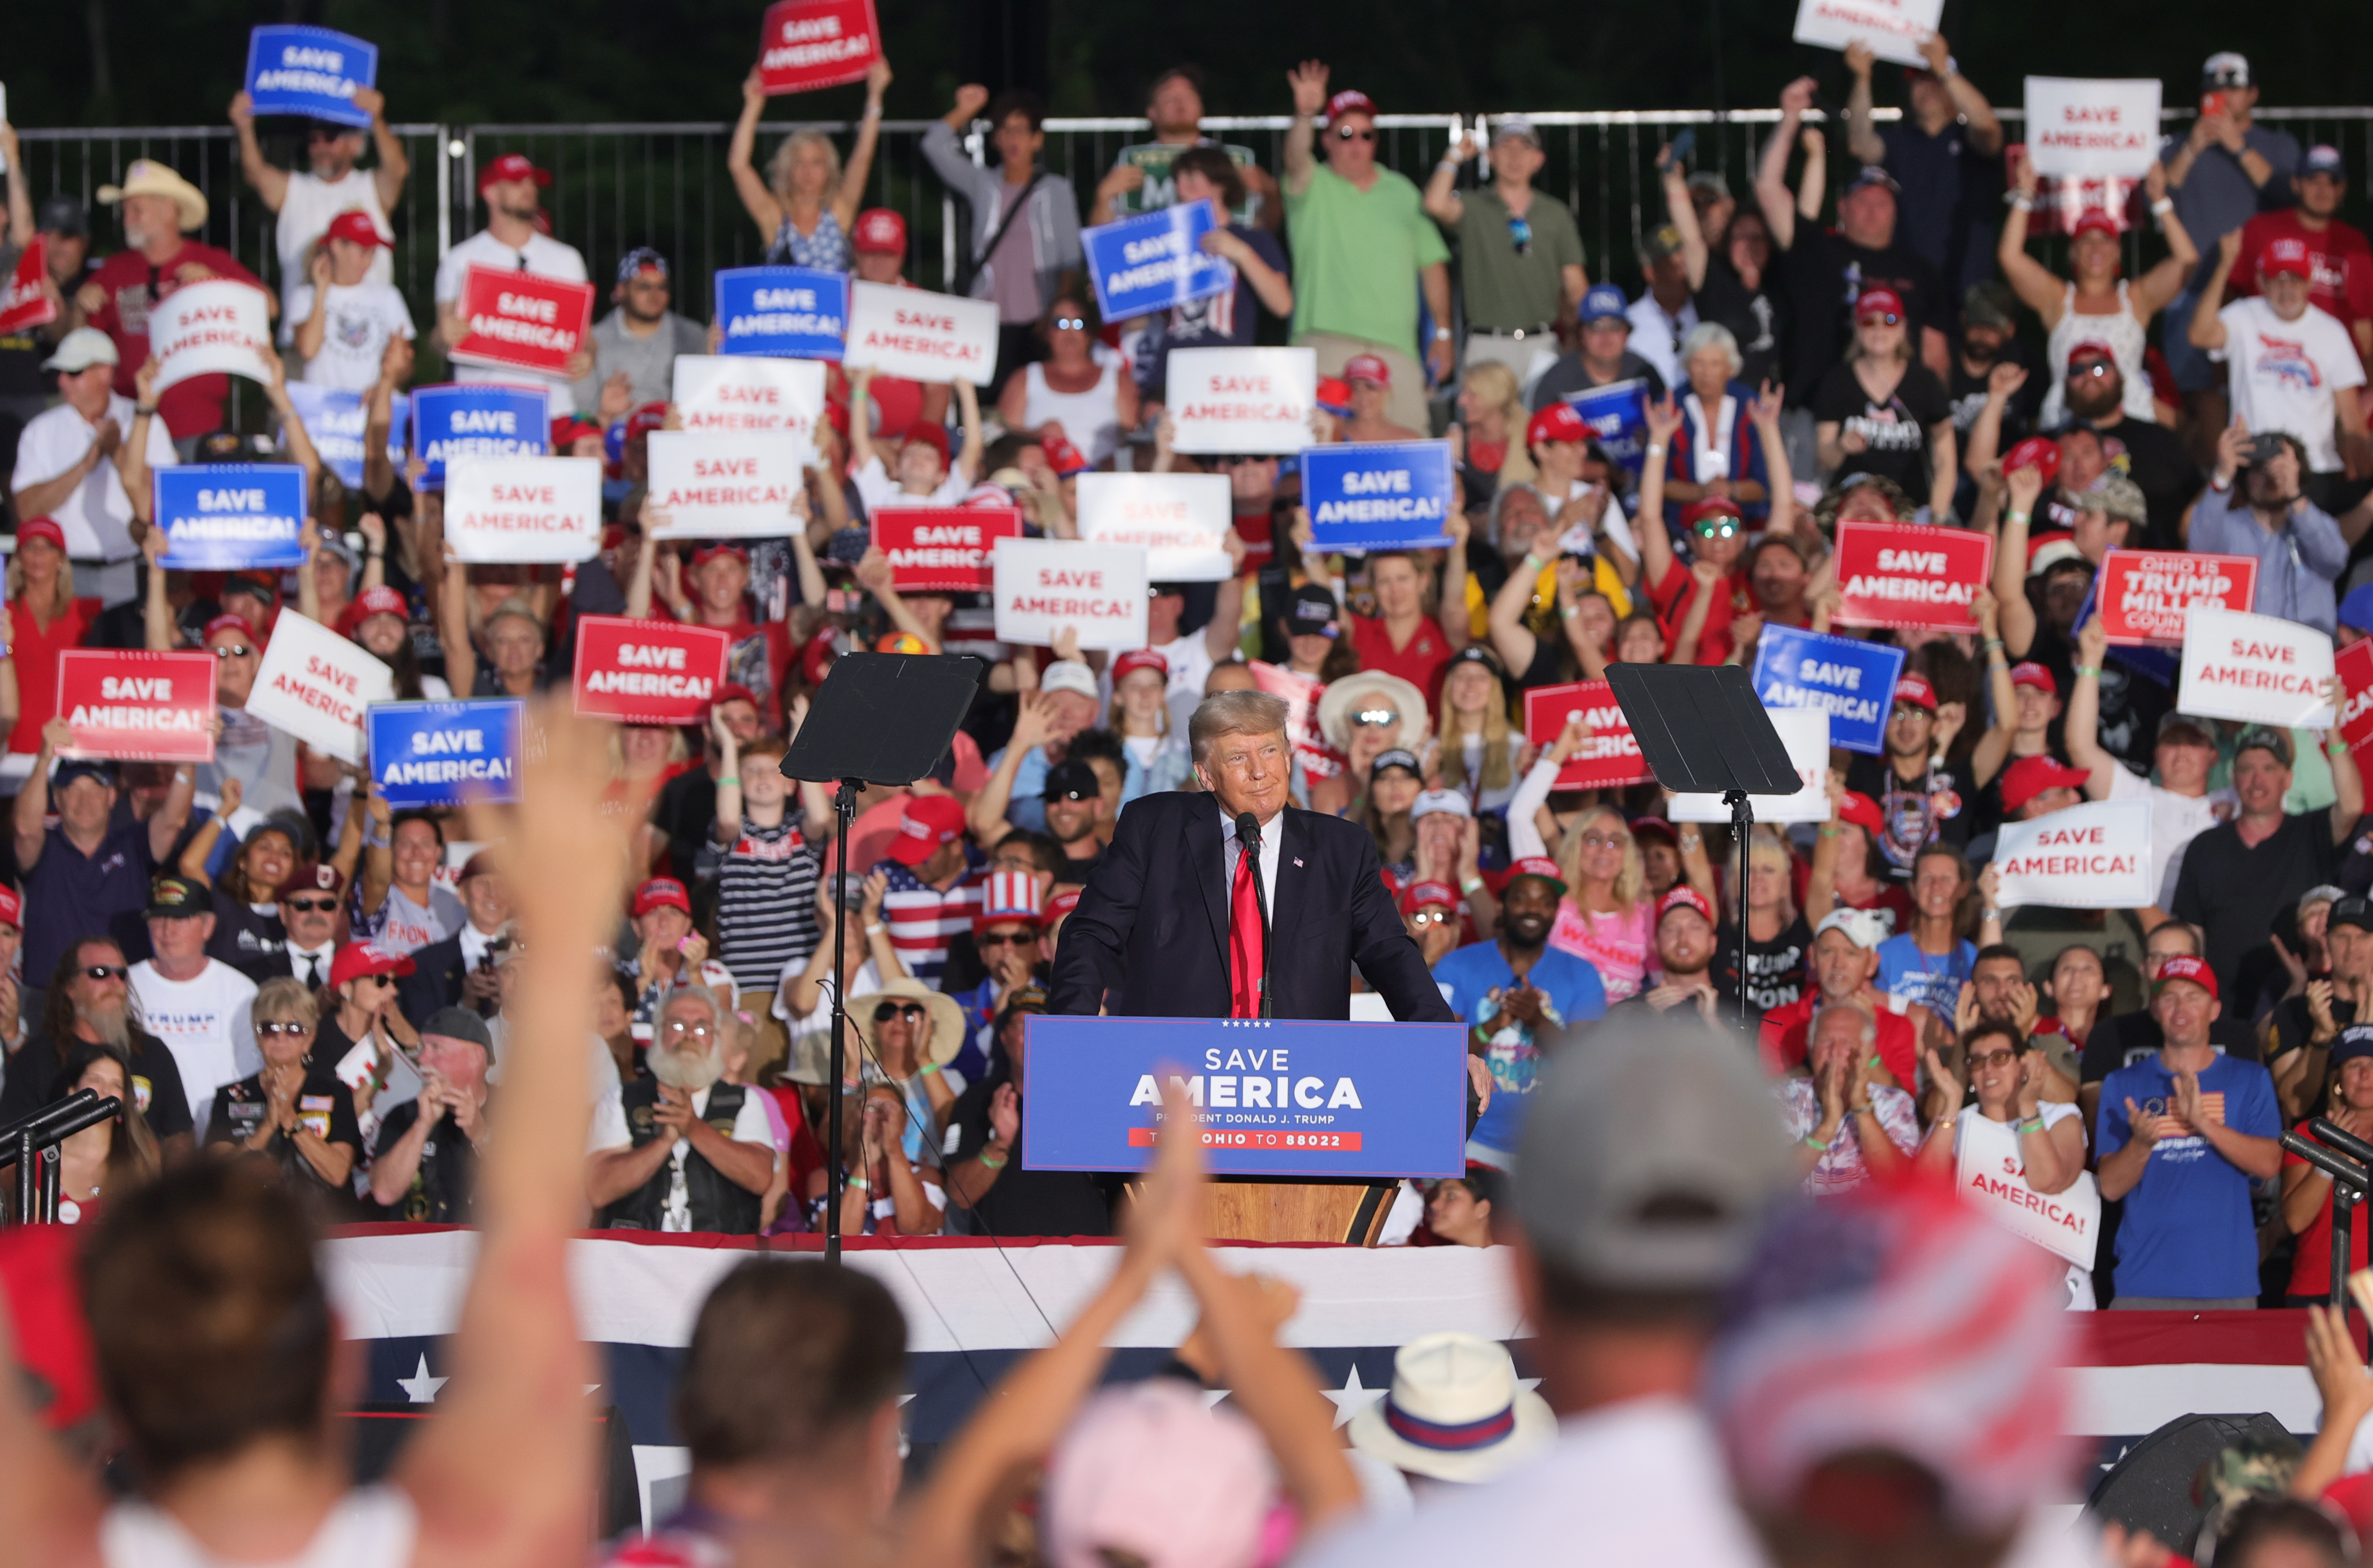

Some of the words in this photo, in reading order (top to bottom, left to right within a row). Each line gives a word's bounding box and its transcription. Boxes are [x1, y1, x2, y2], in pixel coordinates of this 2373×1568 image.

[782, 15, 840, 41] SAVE
[282, 45, 343, 72] SAVE
[763, 33, 869, 69] AMERICA!
[255, 68, 359, 98] AMERICA
[2064, 105, 2121, 123] SAVE
[2041, 131, 2146, 150] AMERICA!
[1123, 232, 1186, 263] SAVE
[498, 292, 560, 322] SAVE
[753, 288, 816, 311] SAVE
[179, 306, 238, 326] SAVE
[728, 314, 841, 338] AMERICA!
[894, 309, 956, 331] SAVE
[467, 313, 578, 352] AMERICA!
[865, 333, 982, 362] AMERICA!
[720, 385, 779, 404] SAVE
[1209, 376, 1271, 393] SAVE
[451, 410, 516, 434] SAVE
[1182, 404, 1300, 422] AMERICA!
[425, 437, 541, 461] AMERICA!
[694, 459, 757, 478] SAVE
[493, 484, 556, 504] SAVE
[1343, 470, 1412, 495] SAVE
[197, 489, 265, 511] SAVE
[666, 486, 788, 507] AMERICA!
[462, 511, 585, 532] AMERICA!
[1315, 497, 1441, 524] AMERICA!
[169, 515, 296, 541] AMERICA!
[914, 525, 981, 545] SAVE
[887, 547, 995, 570] AMERICA
[1878, 548, 1947, 574] SAVE
[2139, 557, 2196, 575] OHIO
[2199, 561, 2220, 575] IS
[1040, 568, 1103, 589] SAVE
[1845, 575, 1976, 605] AMERICA!
[2123, 570, 2232, 596] TRUMP
[1011, 597, 1133, 618] AMERICA!
[618, 644, 686, 669] SAVE
[2231, 639, 2295, 664] SAVE
[307, 655, 360, 696] SAVE
[586, 671, 712, 699] AMERICA!
[1800, 658, 1862, 690] SAVE
[101, 676, 173, 701] SAVE
[272, 675, 366, 732] AMERICA
[68, 704, 201, 730] AMERICA!
[1566, 707, 1629, 729] SAV
[411, 729, 483, 754] SAVE
[382, 757, 512, 785] AMERICA!
[2038, 827, 2105, 846] SAVE
[2004, 855, 2135, 877] AMERICA!
[1562, 924, 1641, 965] WOMEN
[147, 1013, 215, 1024] TRUMP
[1205, 1048, 1289, 1071] SAVE
[1129, 1074, 1363, 1110] AMERICA
[1226, 1114, 1276, 1124] DONALD
[1280, 1115, 1290, 1124] J.
[1295, 1116, 1335, 1124] TRUMP
[1202, 1133, 1246, 1144] OHIO
[1256, 1134, 1277, 1145] TO
[1286, 1135, 1340, 1146] 88022
[1972, 1173, 2086, 1236] AMERICA!
